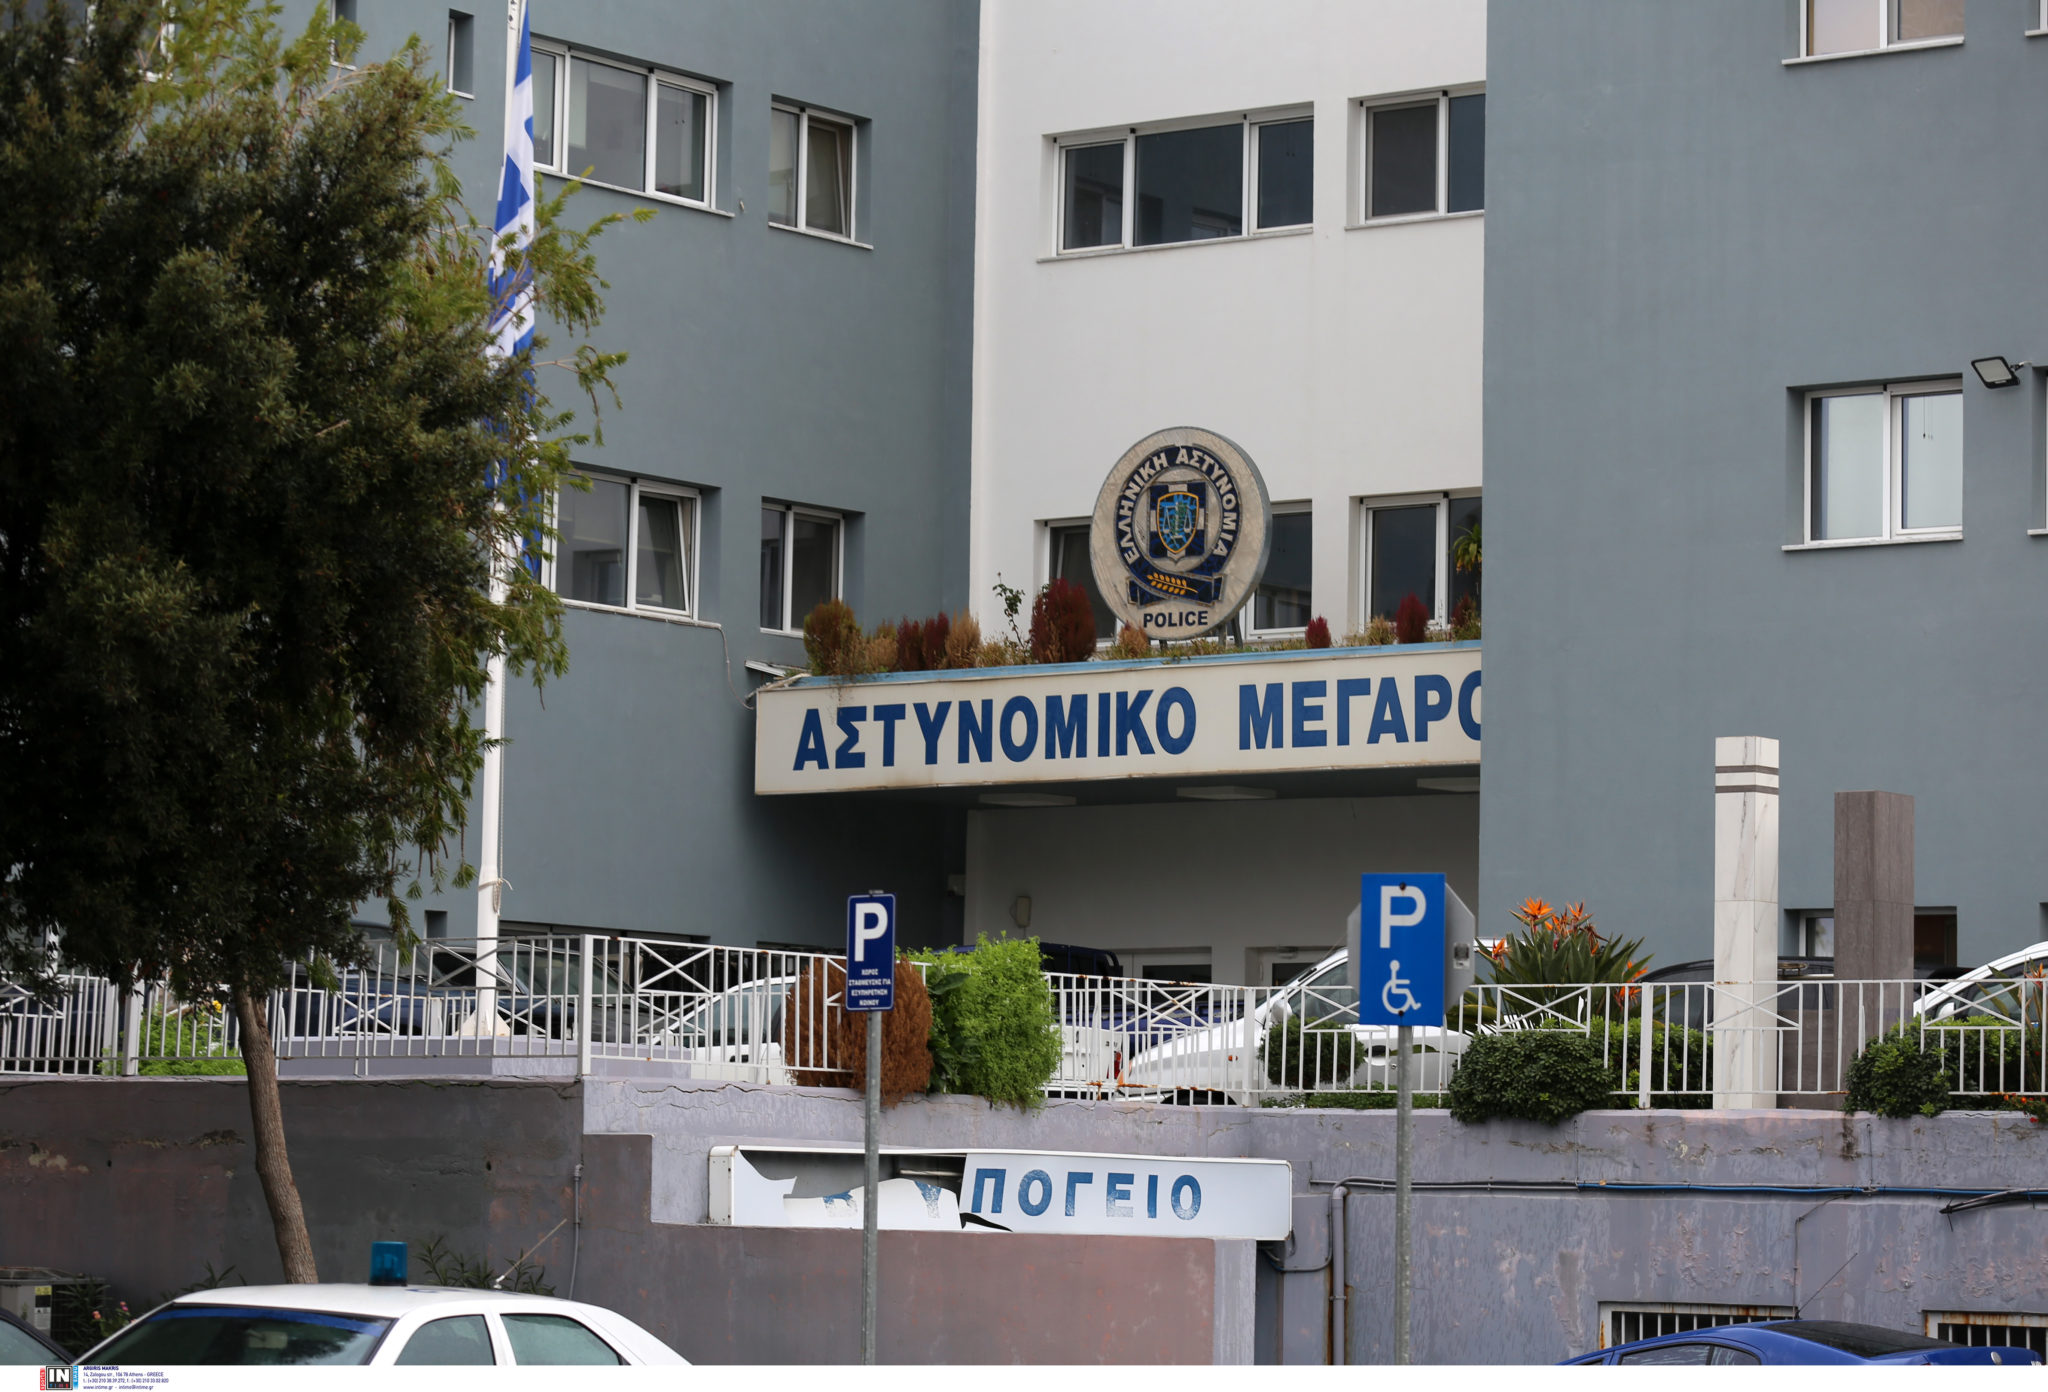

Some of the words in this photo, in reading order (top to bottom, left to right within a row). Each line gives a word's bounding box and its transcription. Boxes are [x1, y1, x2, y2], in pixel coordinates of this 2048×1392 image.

[1117, 453, 1168, 565] ΕΛΛΗΝΙΚΗ
[1175, 448, 1237, 557] ΑΣΤΥΝΟΜΙΑ
[1143, 610, 1208, 628] POLICE
[793, 686, 1197, 772] ΑΣΤΥΝΟΜΙΚΟ
[854, 902, 888, 962] P
[1380, 885, 1427, 948] P
